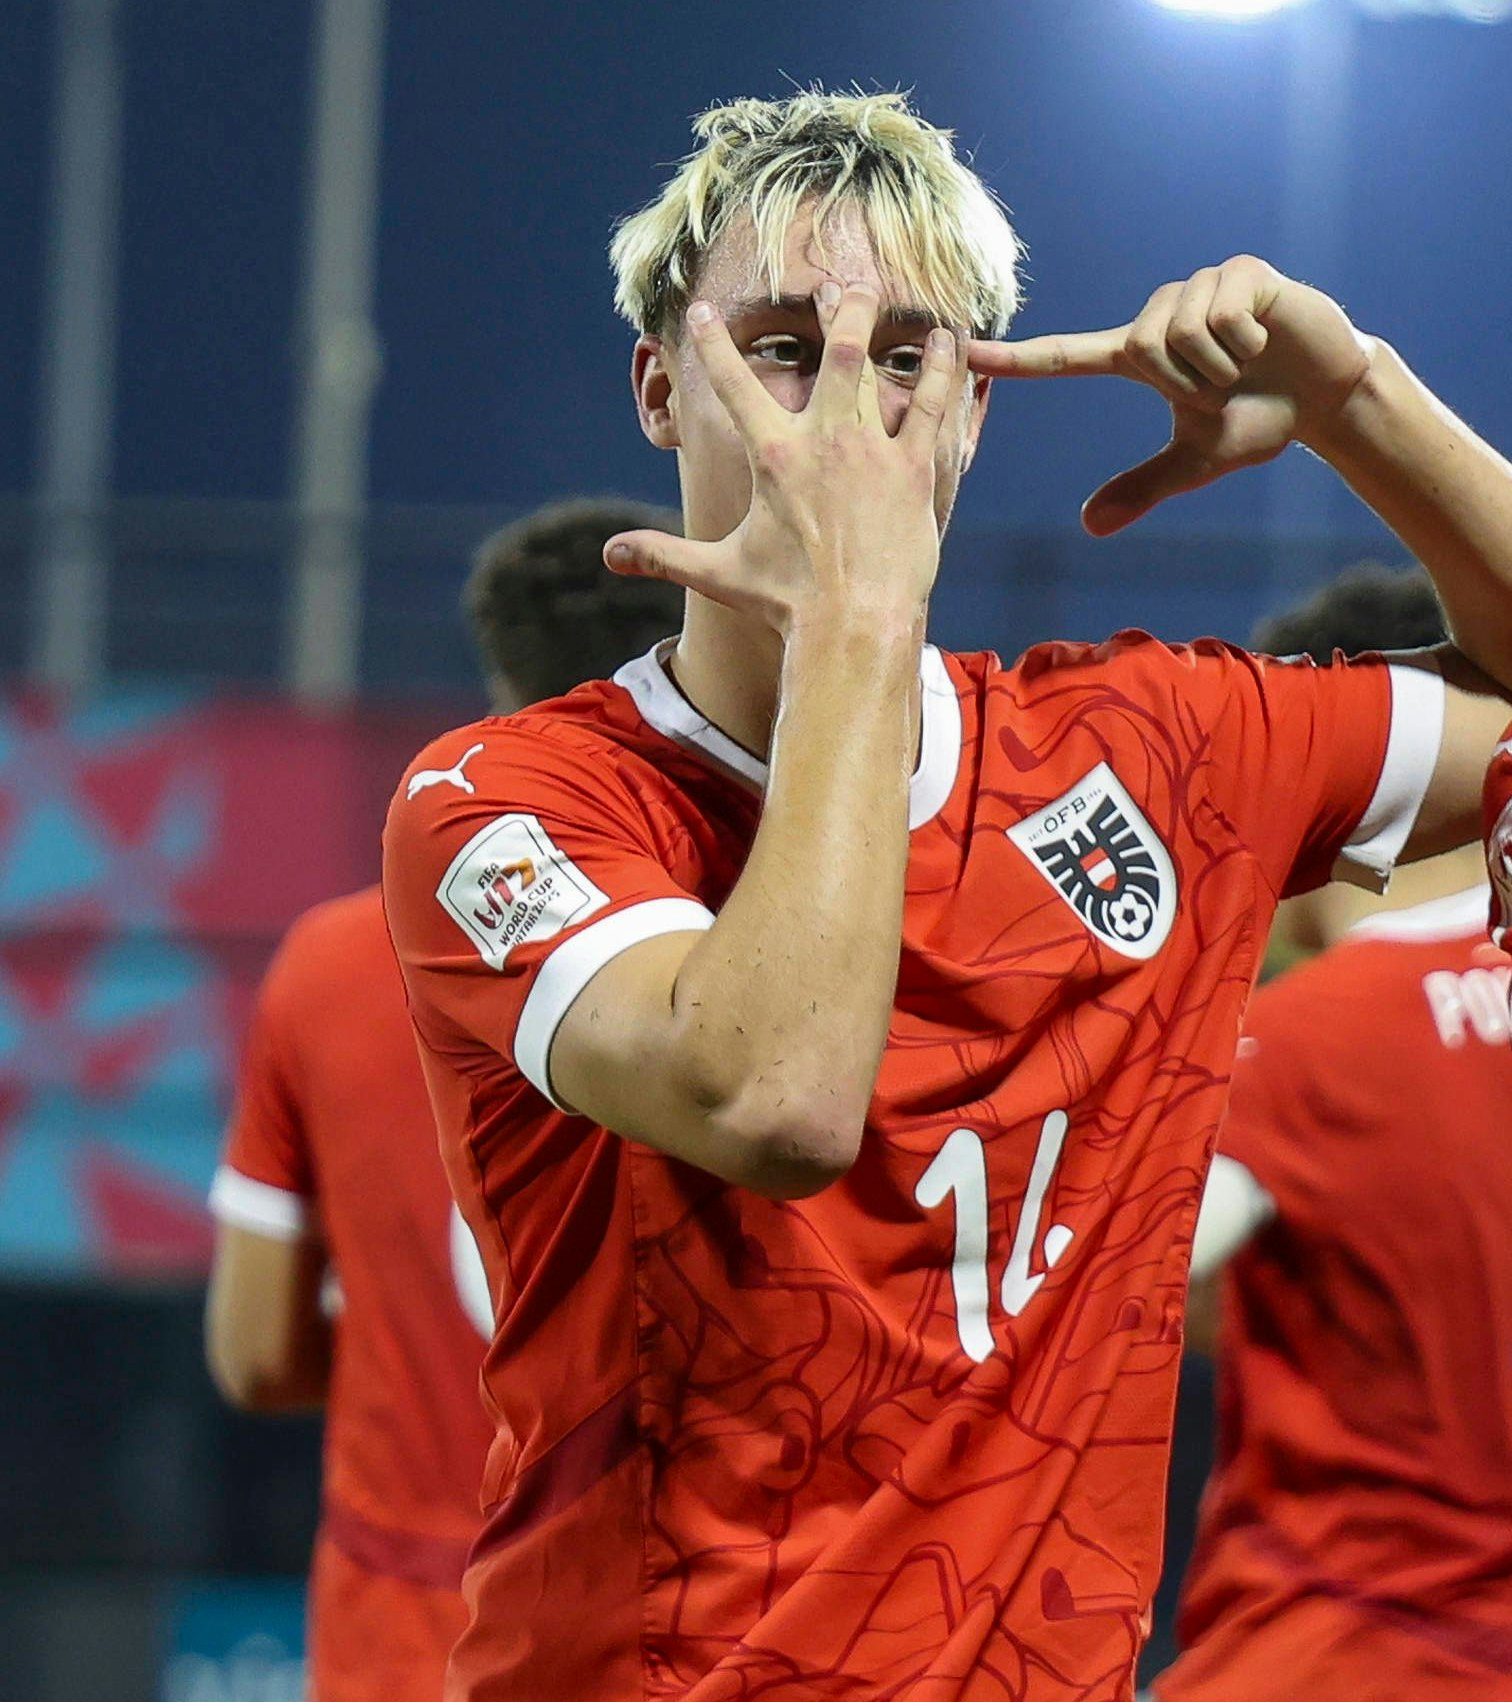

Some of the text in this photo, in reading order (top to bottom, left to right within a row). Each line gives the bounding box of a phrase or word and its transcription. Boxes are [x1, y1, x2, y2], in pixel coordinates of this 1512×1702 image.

[1044, 796, 1086, 833] ÖFB
[478, 862, 499, 890] FIFA
[499, 877, 553, 946] WORLD CUP
